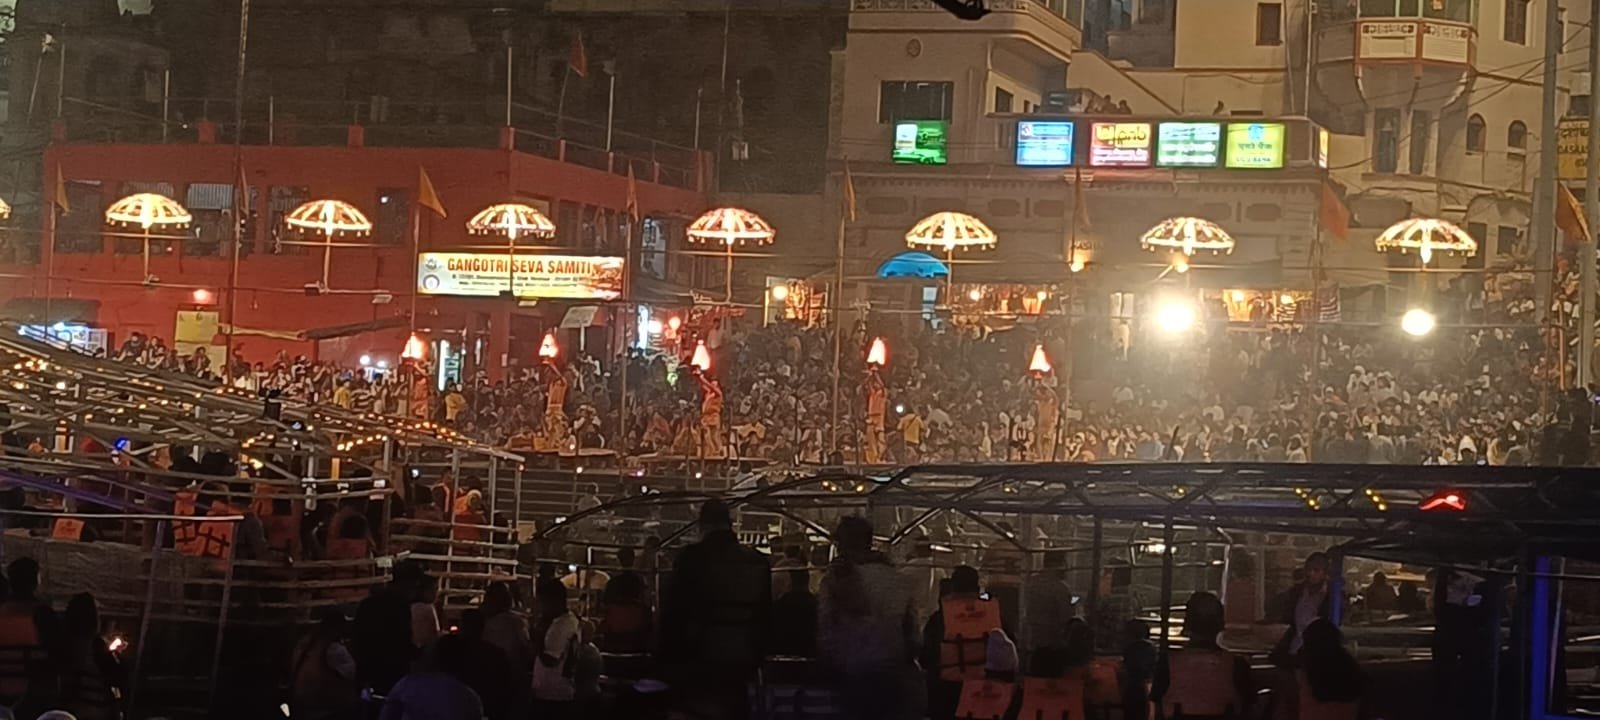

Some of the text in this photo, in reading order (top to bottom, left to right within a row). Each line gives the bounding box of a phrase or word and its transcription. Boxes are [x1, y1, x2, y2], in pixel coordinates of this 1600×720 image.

[448, 258, 591, 274] GANGOTRI SEVA SAMITI
